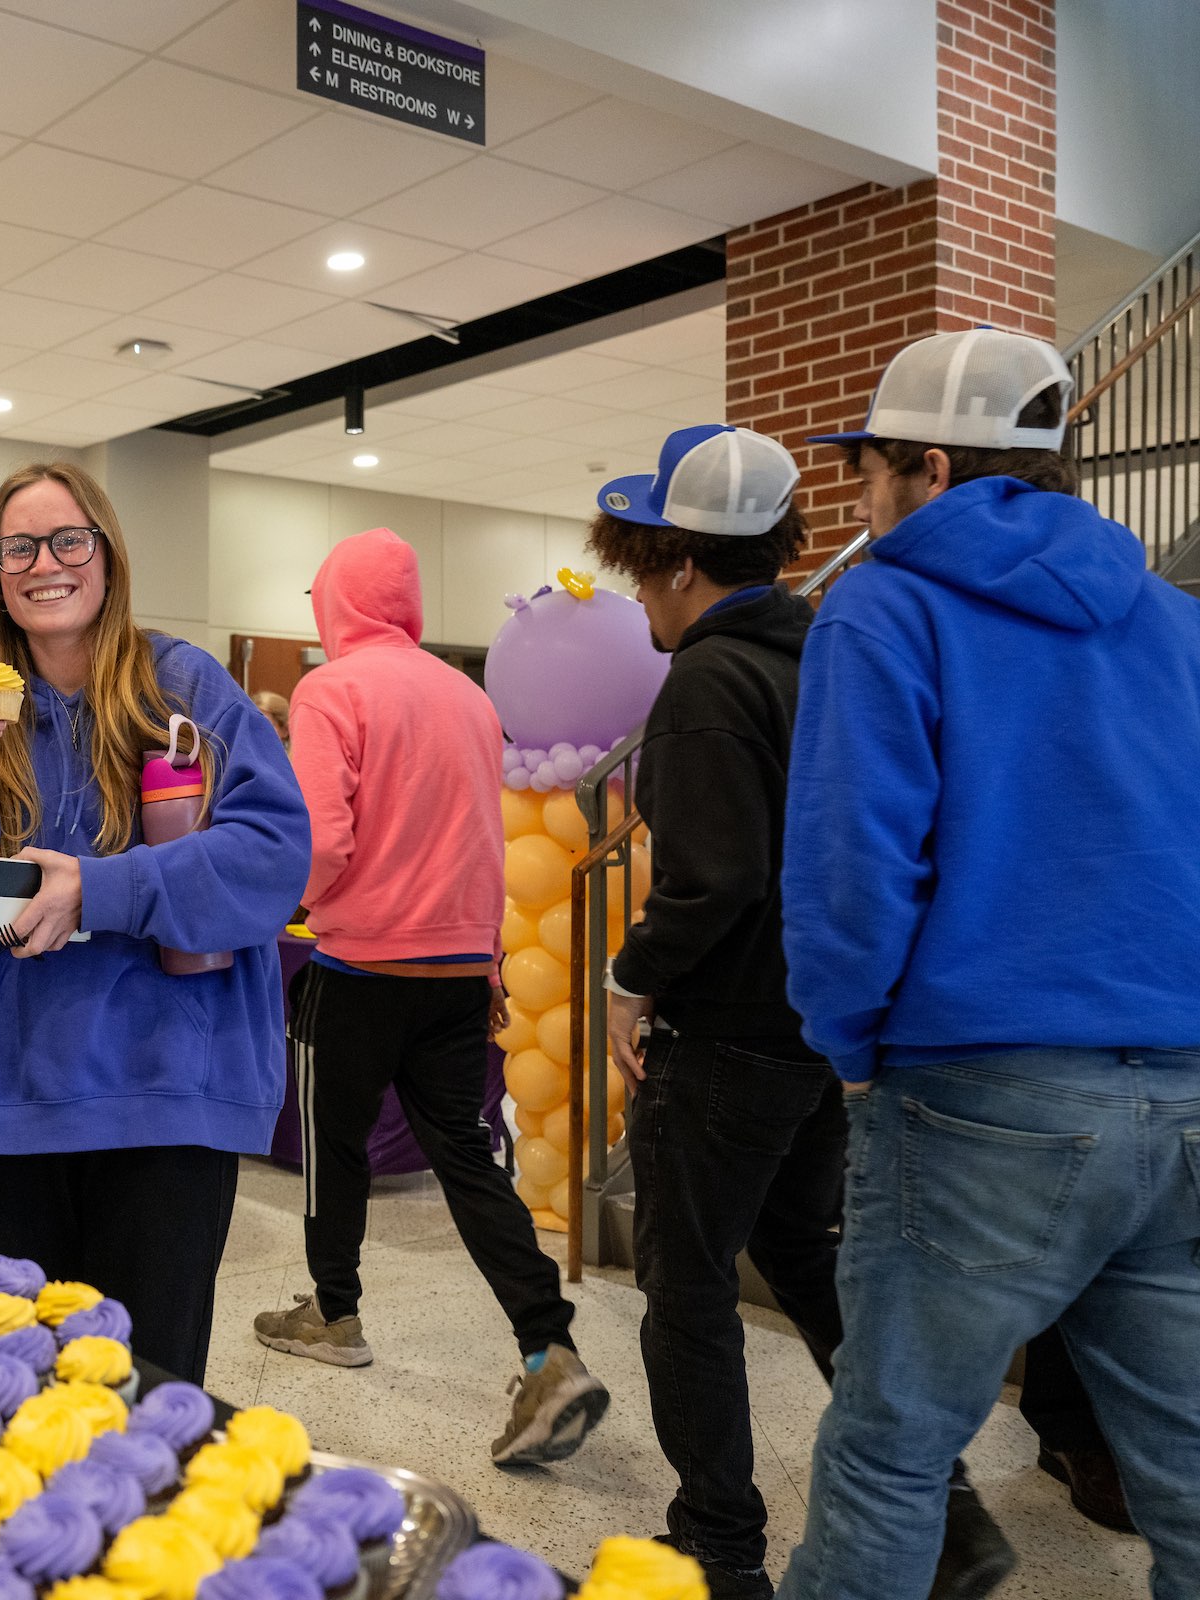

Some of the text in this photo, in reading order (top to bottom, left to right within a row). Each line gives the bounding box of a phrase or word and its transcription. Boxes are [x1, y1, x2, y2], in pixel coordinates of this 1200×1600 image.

[331, 48, 402, 84] ELEVATOR
[332, 23, 481, 86] DINING & BOOKSTORE
[325, 70, 461, 126] M RESTROOMS W
